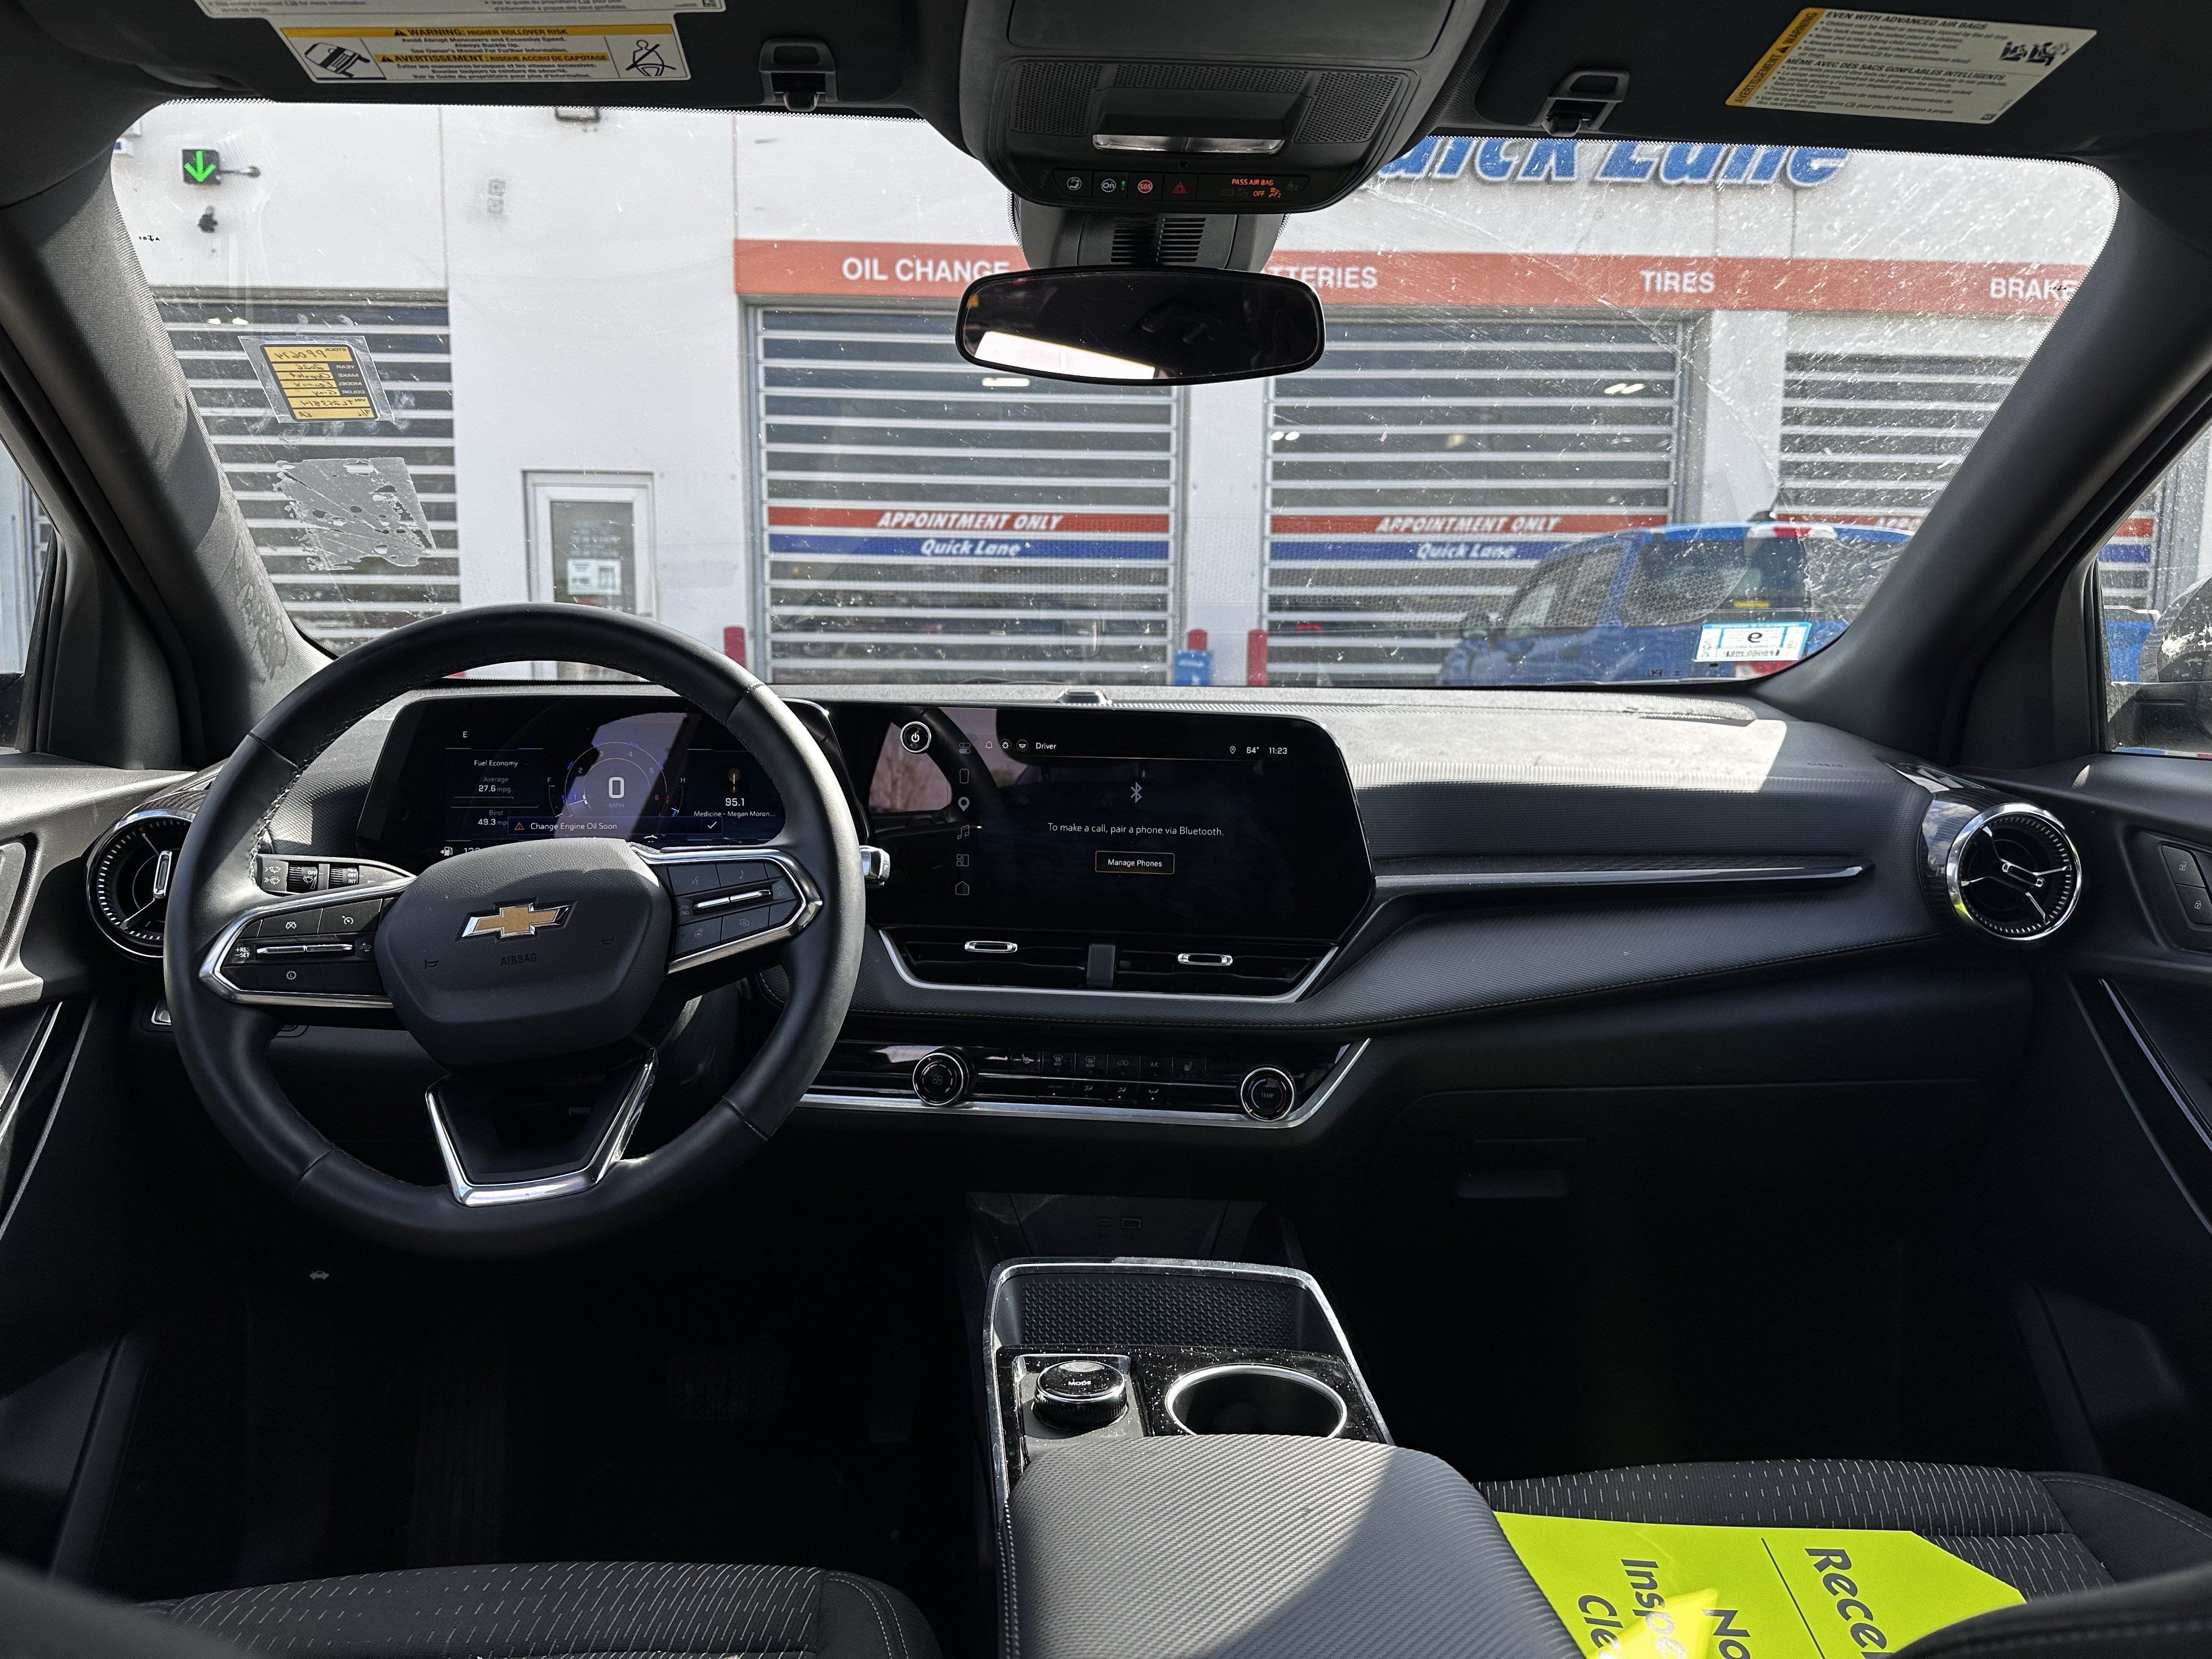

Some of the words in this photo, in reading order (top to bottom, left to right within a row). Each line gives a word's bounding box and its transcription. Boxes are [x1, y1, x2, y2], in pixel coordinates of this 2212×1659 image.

[1882, 16, 1938, 26] ADVANCED
[1885, 66, 1943, 76] GONFLABLES
[1943, 71, 2006, 81] INTELLIGENTS
[842, 256, 889, 281] OIL
[894, 258, 1010, 283] CHANGE
[1266, 265, 1379, 289] TTERIES
[1639, 269, 1715, 294] TIRES
[1990, 276, 2078, 300] BRAKE
[878, 511, 1010, 529] APPOINTMENT
[1013, 514, 1063, 530] ONLY
[1375, 516, 1509, 533] APPOINTMENT
[1510, 516, 1563, 532] ONLY
[921, 539, 973, 556] Quick
[974, 540, 1022, 557] Lane
[1416, 543, 1469, 560] Quick
[1469, 543, 1518, 559] Lane
[1246, 747, 1260, 755] 64°
[608, 776, 625, 799] 0
[725, 798, 744, 806] 95.1
[530, 822, 558, 831] Change
[560, 822, 585, 831] Engine
[1048, 823, 1058, 831] To
[1060, 823, 1082, 832] make
[1091, 824, 1108, 833] call,
[1110, 825, 1126, 834] pair
[1136, 825, 1163, 836] phone
[1179, 826, 1224, 836] Bluetooth.
[1108, 859, 1135, 867] Manage
[501, 953, 538, 966] AIRBAG
[1621, 1558, 1688, 1659] Inspe
